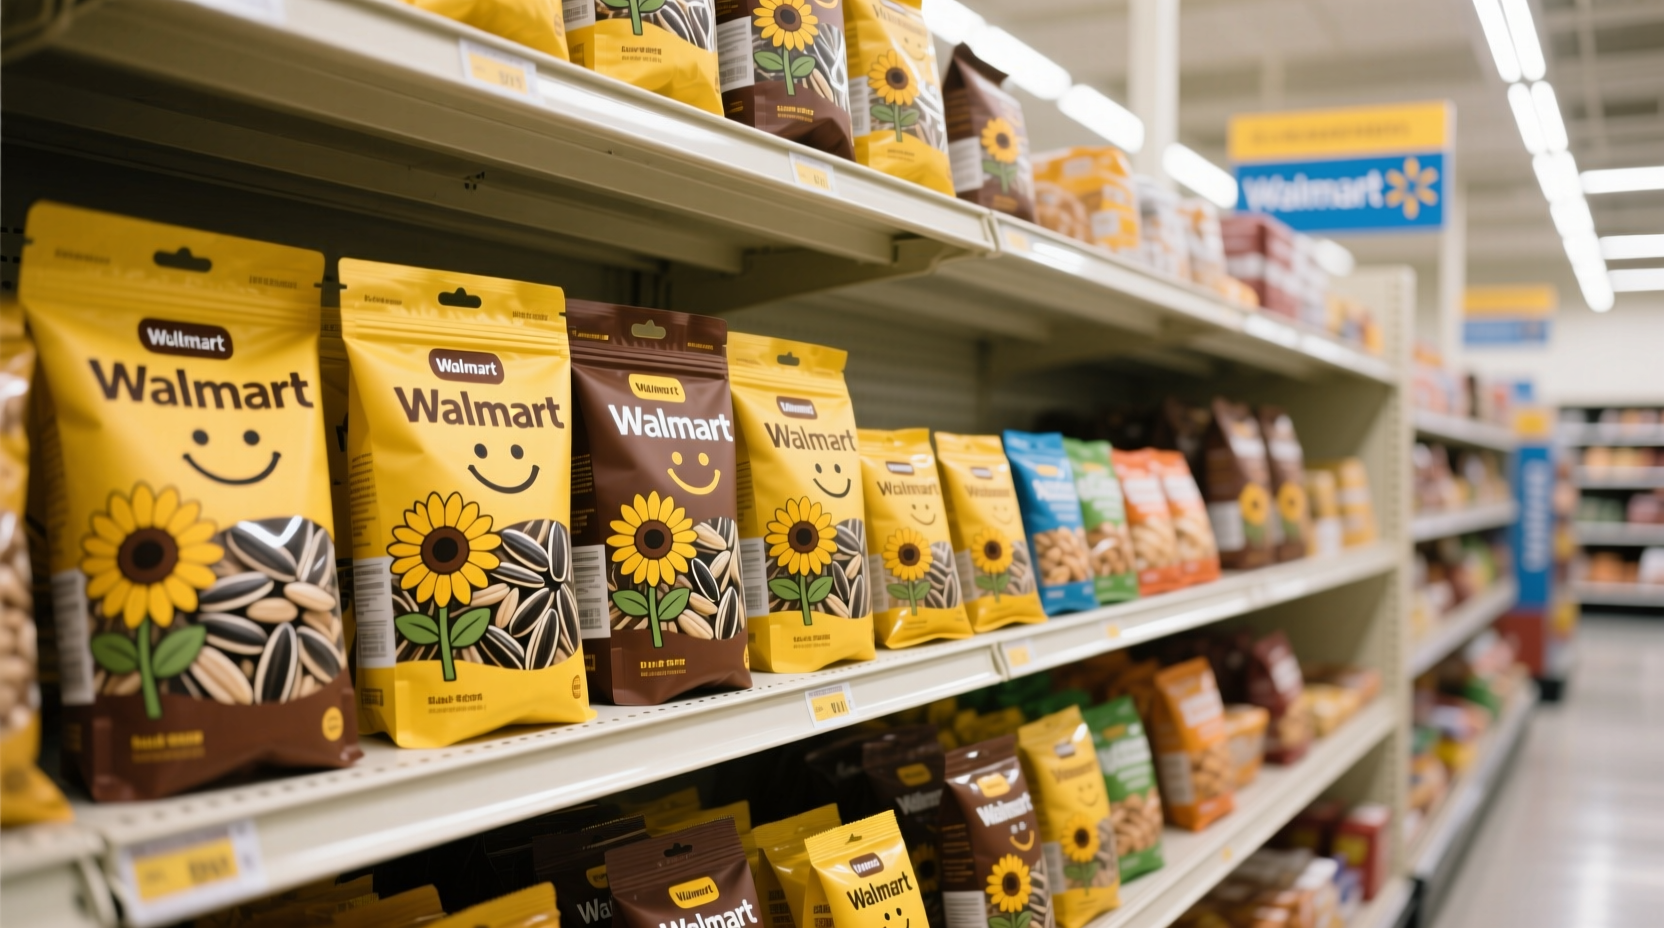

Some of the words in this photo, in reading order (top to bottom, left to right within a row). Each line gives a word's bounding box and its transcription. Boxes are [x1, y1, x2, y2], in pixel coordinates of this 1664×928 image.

[88, 359, 314, 410] Walmart
[393, 386, 565, 429] Walmart
[608, 404, 733, 442] Walmart
[764, 422, 856, 452] Walmart
[846, 871, 913, 911] Walmart
